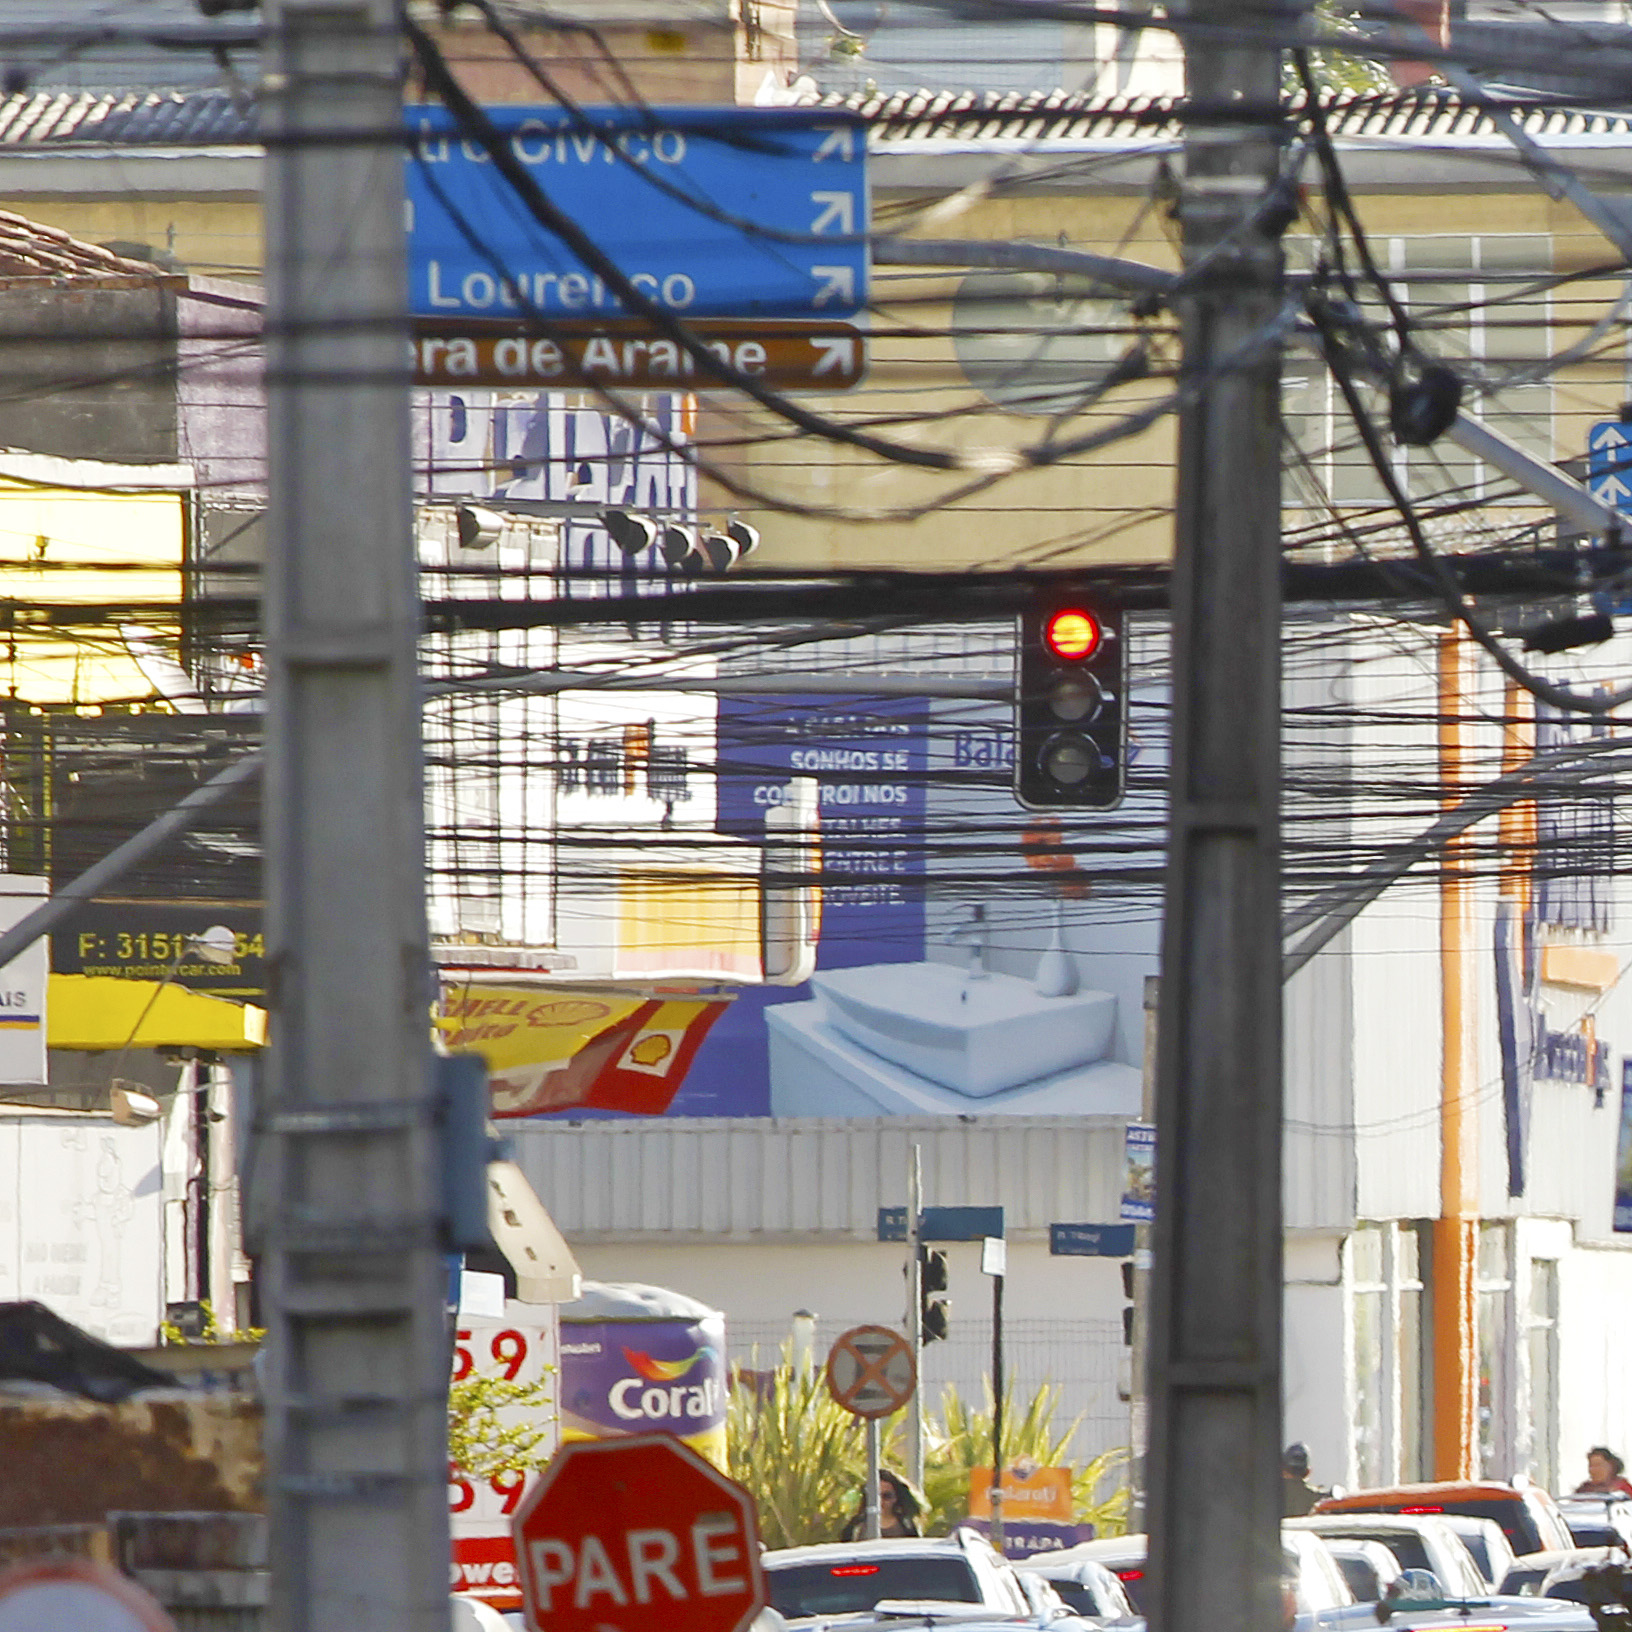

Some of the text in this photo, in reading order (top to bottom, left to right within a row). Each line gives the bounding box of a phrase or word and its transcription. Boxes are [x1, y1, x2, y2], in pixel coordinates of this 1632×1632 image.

[493, 326, 565, 377] de
[790, 750, 909, 771] SONHOS SE
[864, 784, 908, 804] NOS
[78, 932, 107, 959] F:
[608, 1377, 714, 1419] Coral
[530, 1511, 746, 1612] PARE
